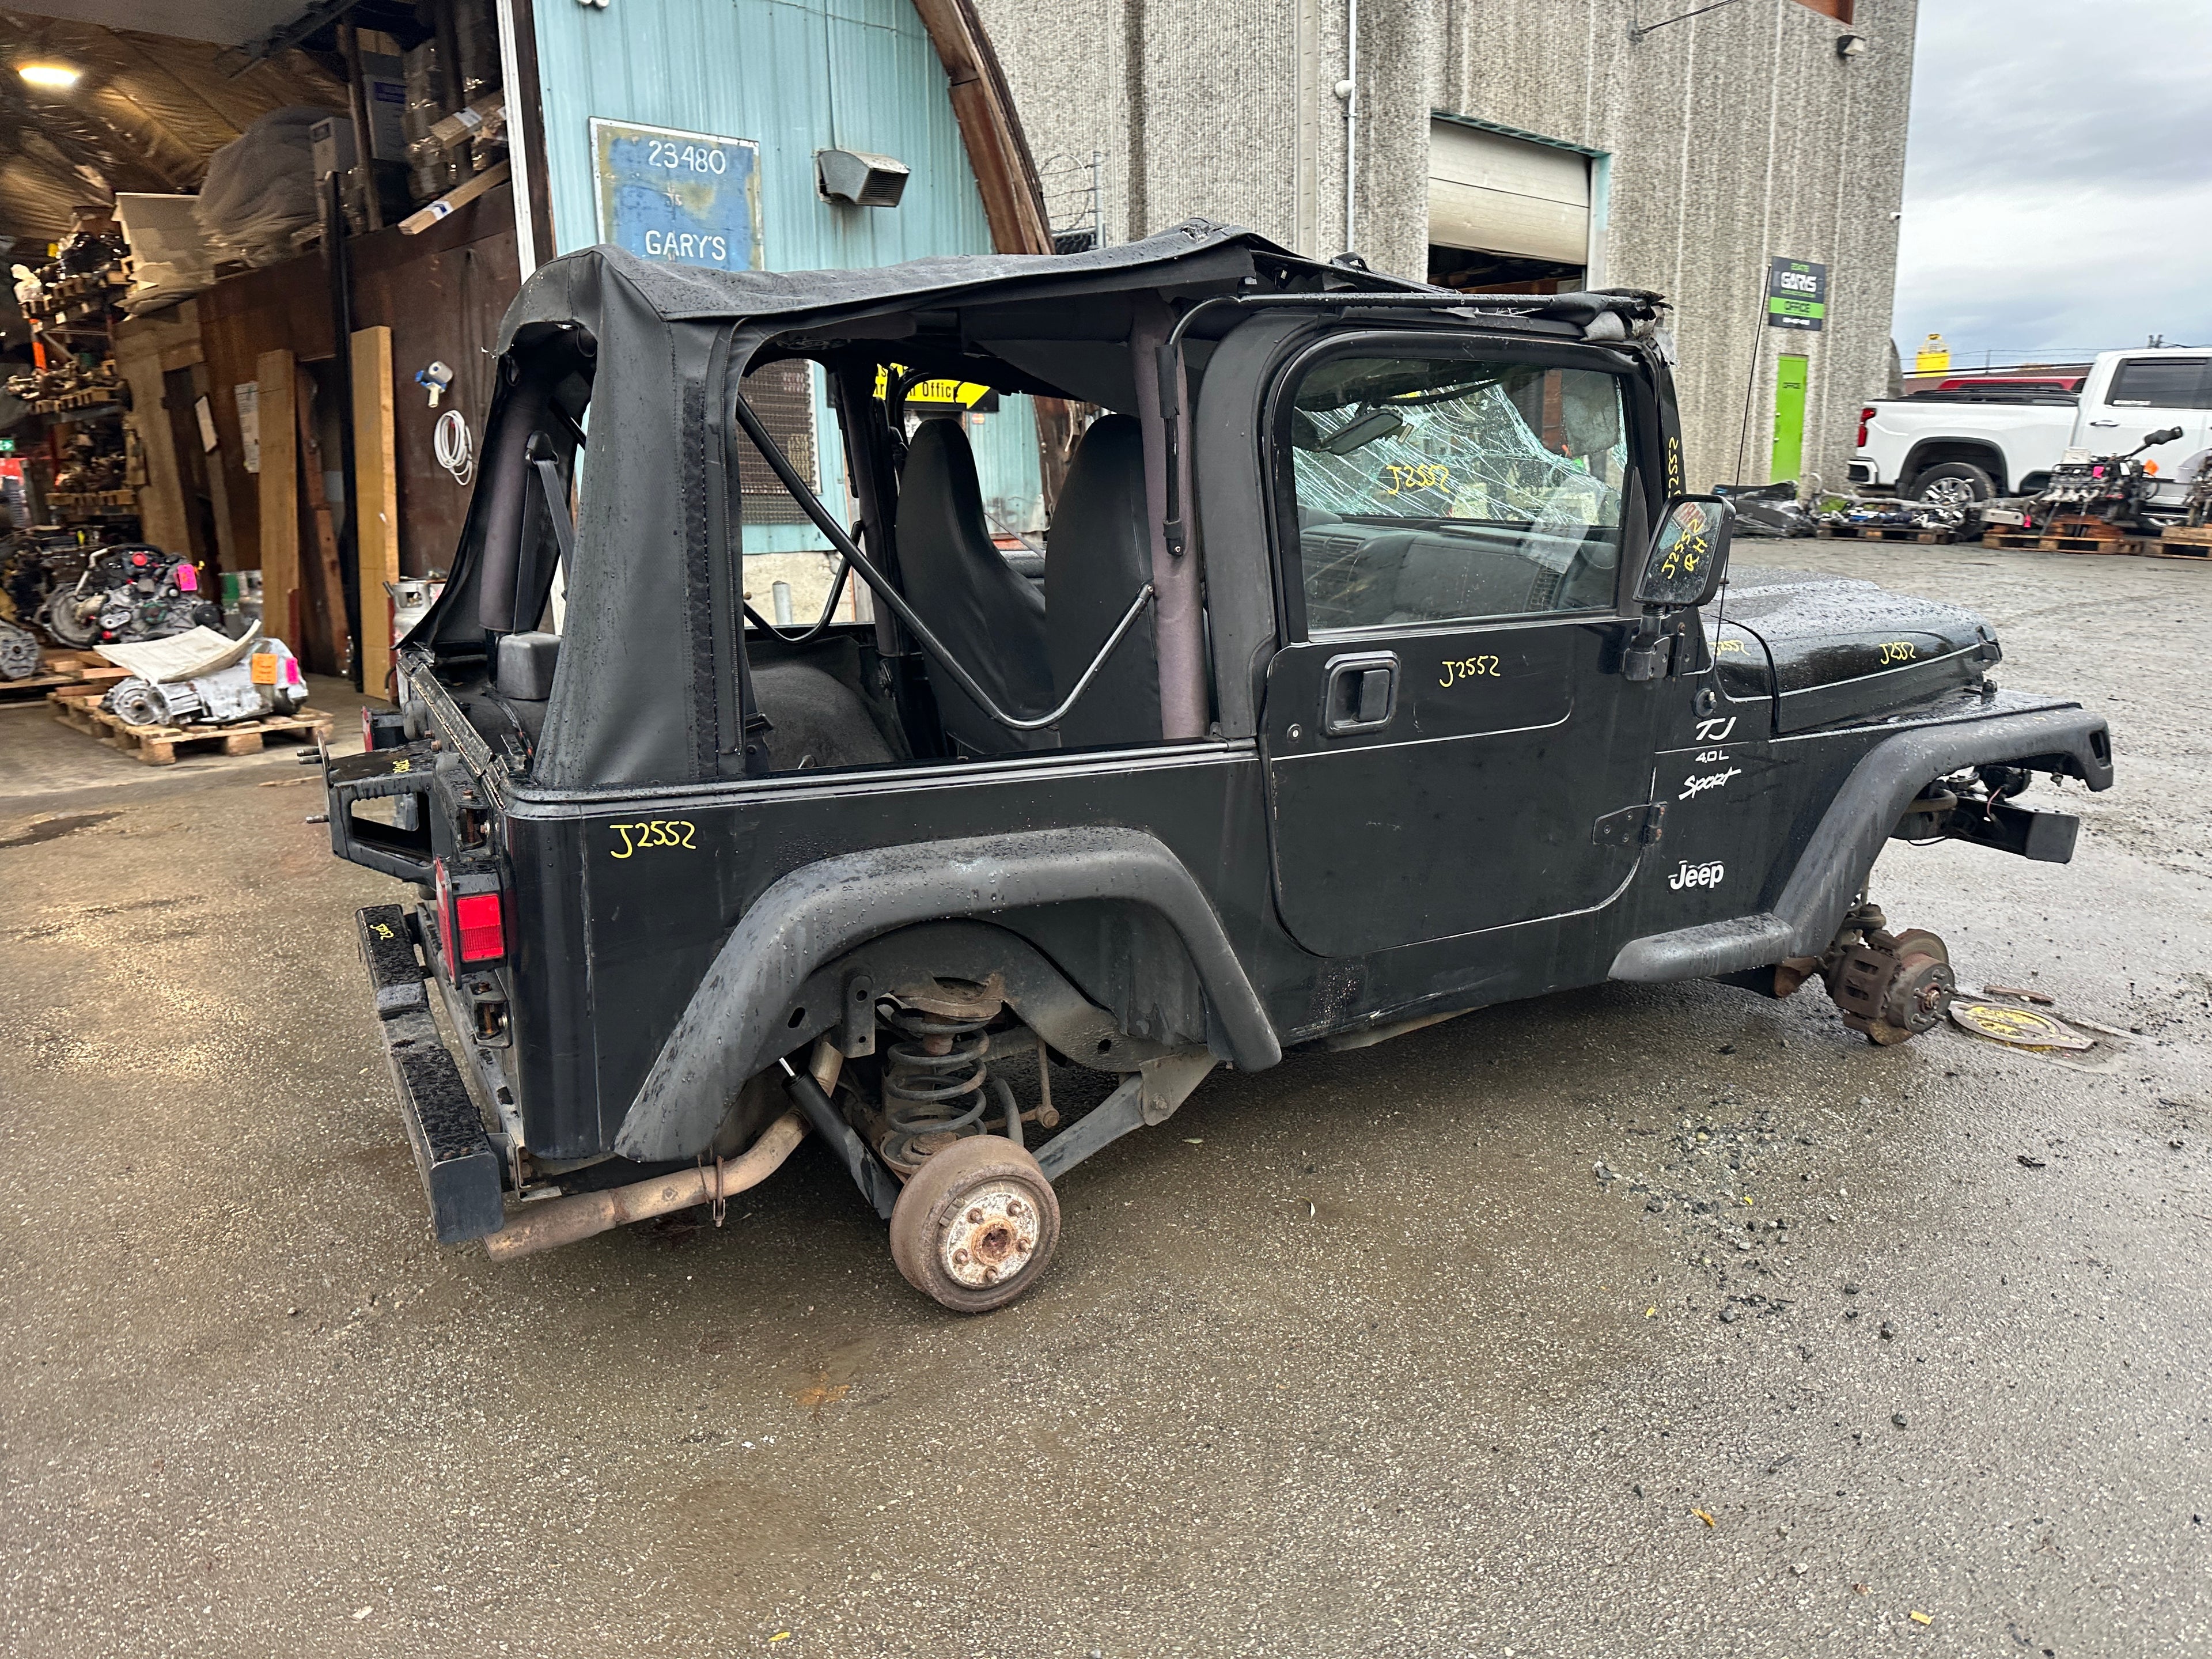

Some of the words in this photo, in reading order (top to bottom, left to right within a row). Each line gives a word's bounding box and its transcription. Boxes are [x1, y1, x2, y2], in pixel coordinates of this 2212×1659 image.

[648, 140, 726, 175] 23480
[645, 230, 726, 261] GARY'S
[923, 381, 958, 397] Offic
[1386, 464, 1450, 495] J2552
[1661, 518, 1703, 579] J2552
[1684, 536, 1708, 571] RH
[1879, 641, 1916, 665] J2552
[1439, 655, 1501, 688] J2552
[1696, 717, 1737, 740] TJ
[609, 820, 696, 859] J2552
[1668, 860, 1724, 890] Jeep
